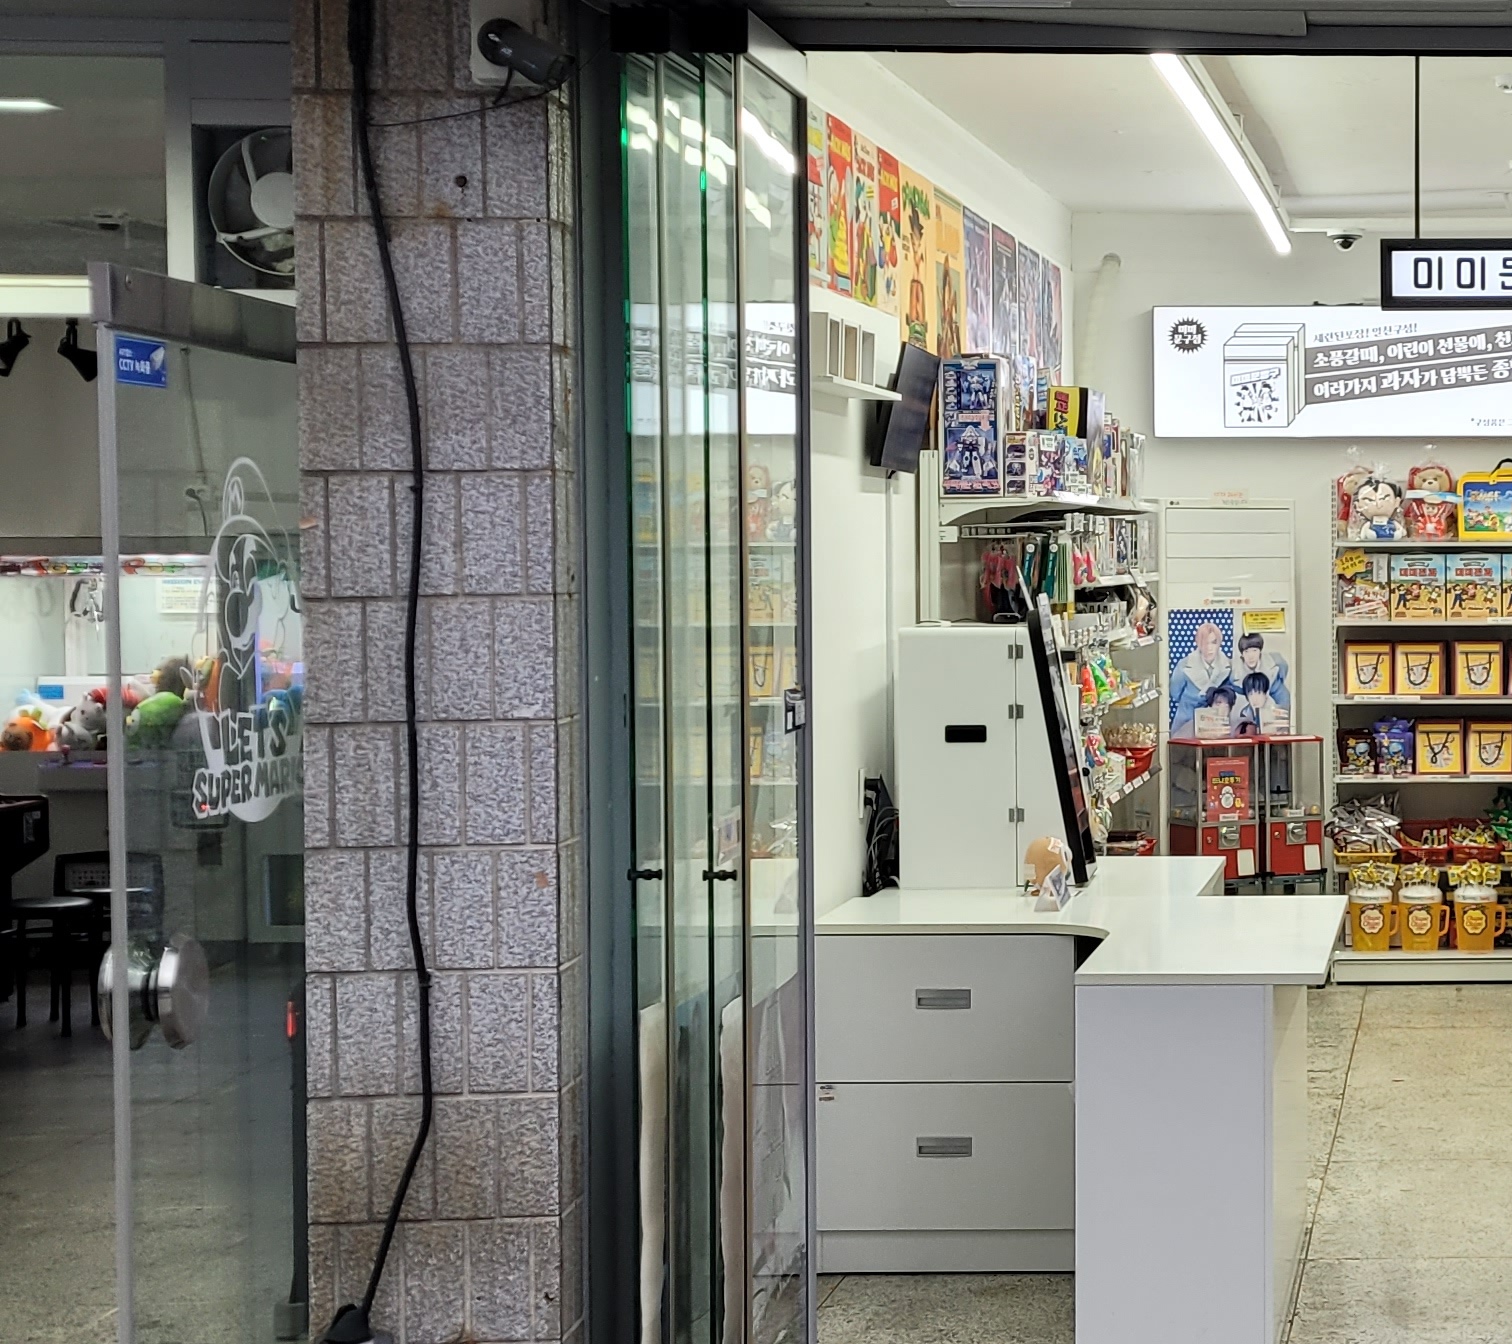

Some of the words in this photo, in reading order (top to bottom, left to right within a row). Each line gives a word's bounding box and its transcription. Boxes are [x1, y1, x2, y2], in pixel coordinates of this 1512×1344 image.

[1312, 345, 1386, 368] 소풍갈때,
[1312, 376, 1378, 400] 여러가지
[1379, 366, 1439, 392] 과자가
[192, 763, 254, 819] SUPER
